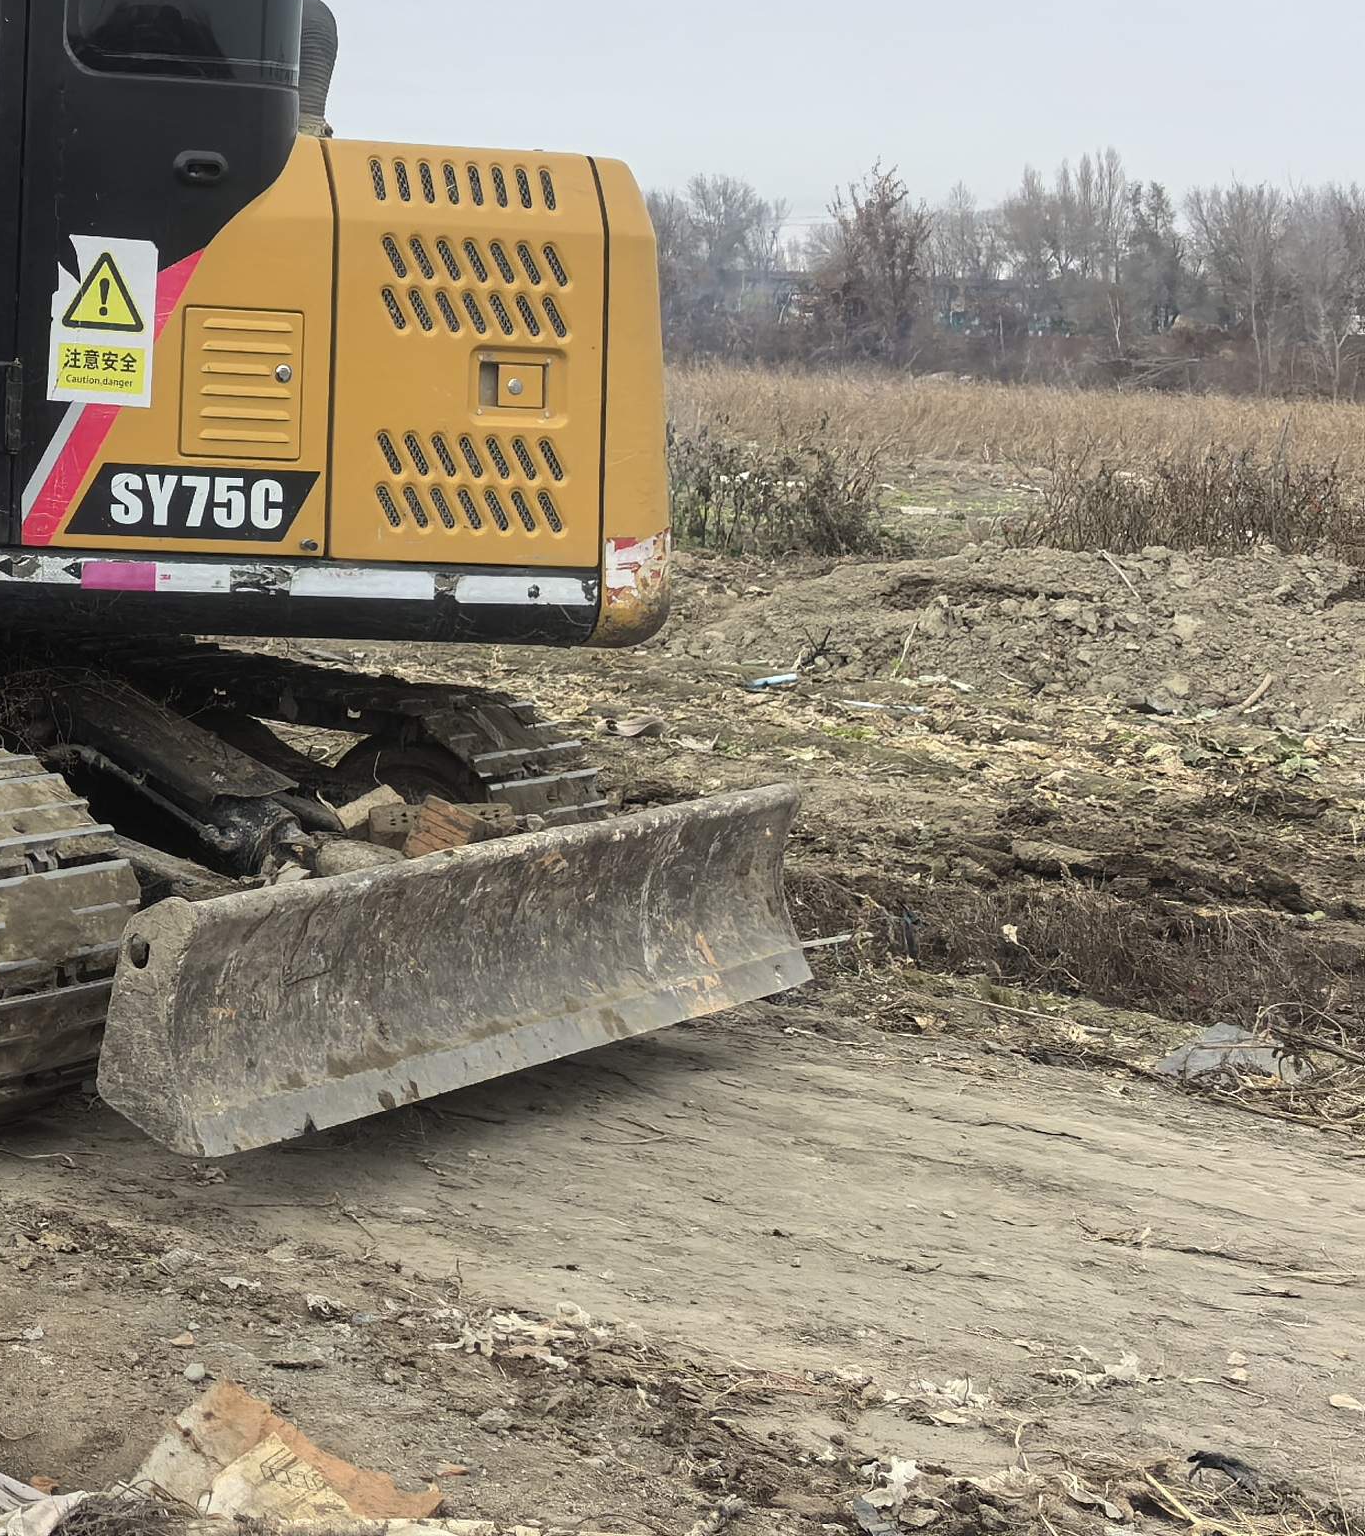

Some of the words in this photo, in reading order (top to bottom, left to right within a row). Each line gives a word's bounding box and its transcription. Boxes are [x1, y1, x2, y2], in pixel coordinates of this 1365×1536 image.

[63, 347, 138, 374] 注意安全
[109, 472, 284, 530] SY75C
